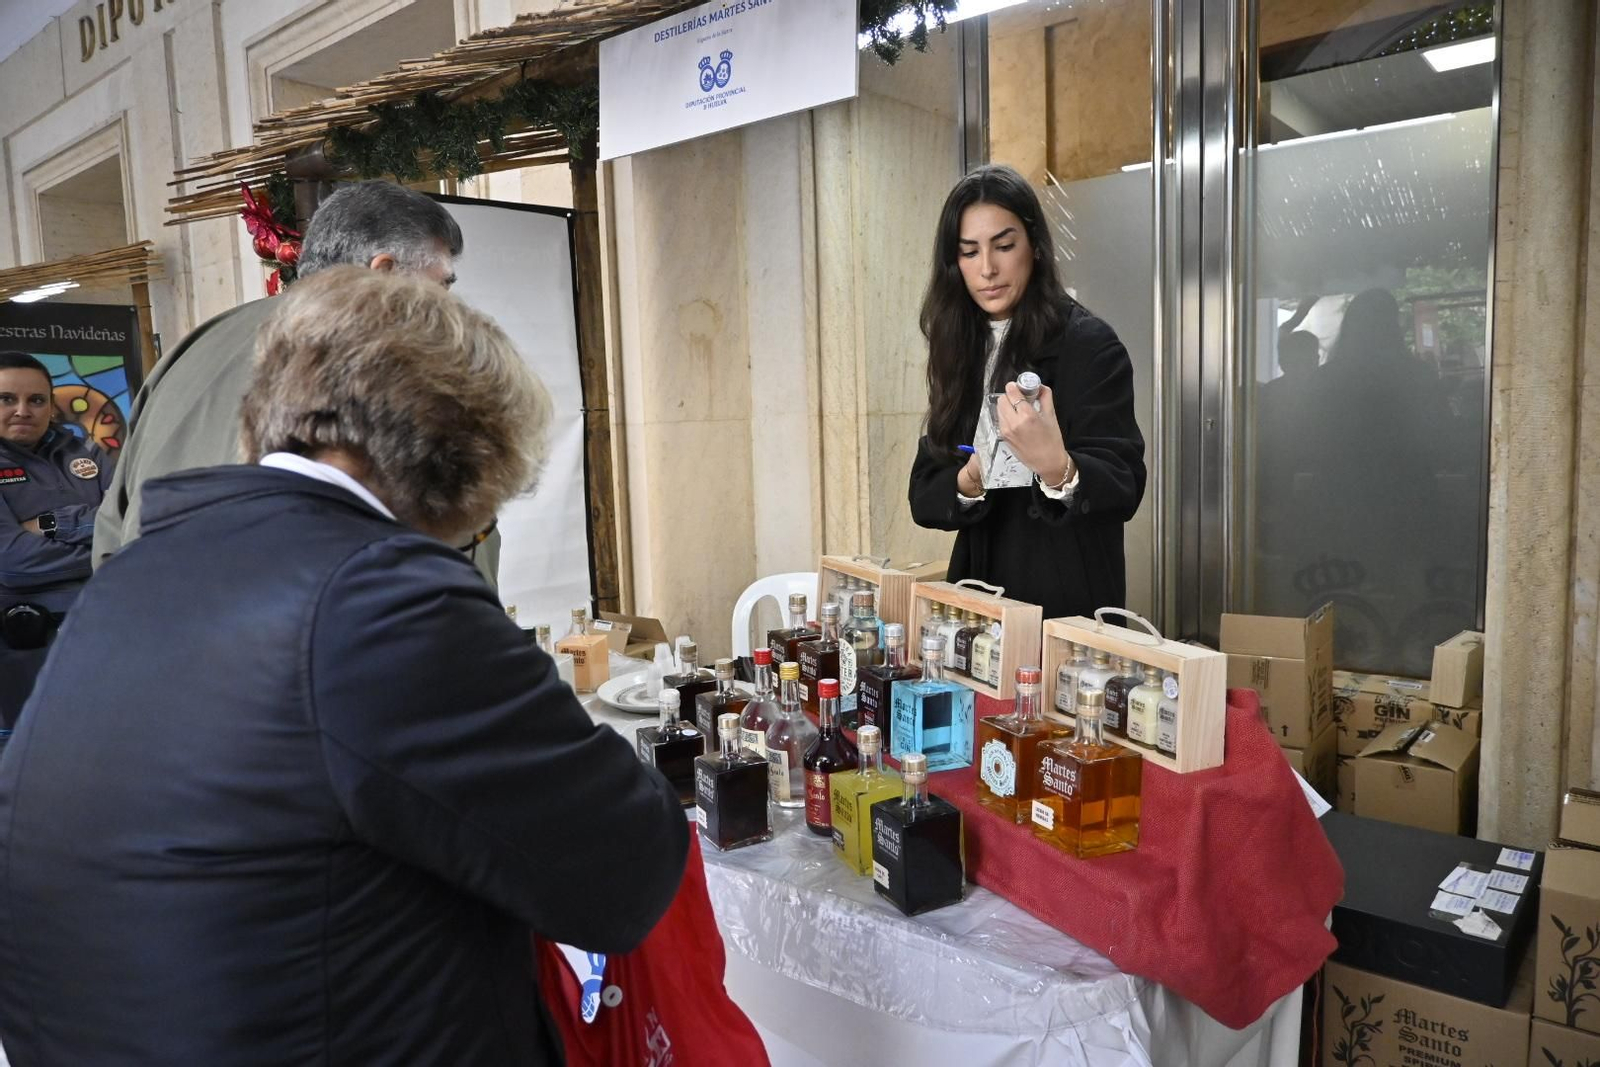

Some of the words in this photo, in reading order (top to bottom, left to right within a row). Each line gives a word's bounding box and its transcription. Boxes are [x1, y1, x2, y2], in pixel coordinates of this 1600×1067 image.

[654, 15, 707, 43] DESTILERÍAS
[709, 2, 746, 24] MARTES
[50, 325, 126, 342] Navideñas
[1374, 705, 1410, 720] GIN
[1040, 756, 1077, 782] Martes
[1043, 771, 1074, 796] Santo
[875, 817, 899, 843] Martes
[877, 832, 899, 855] Santo
[1393, 1008, 1470, 1042] Martes
[1398, 1026, 1462, 1057] Santo
